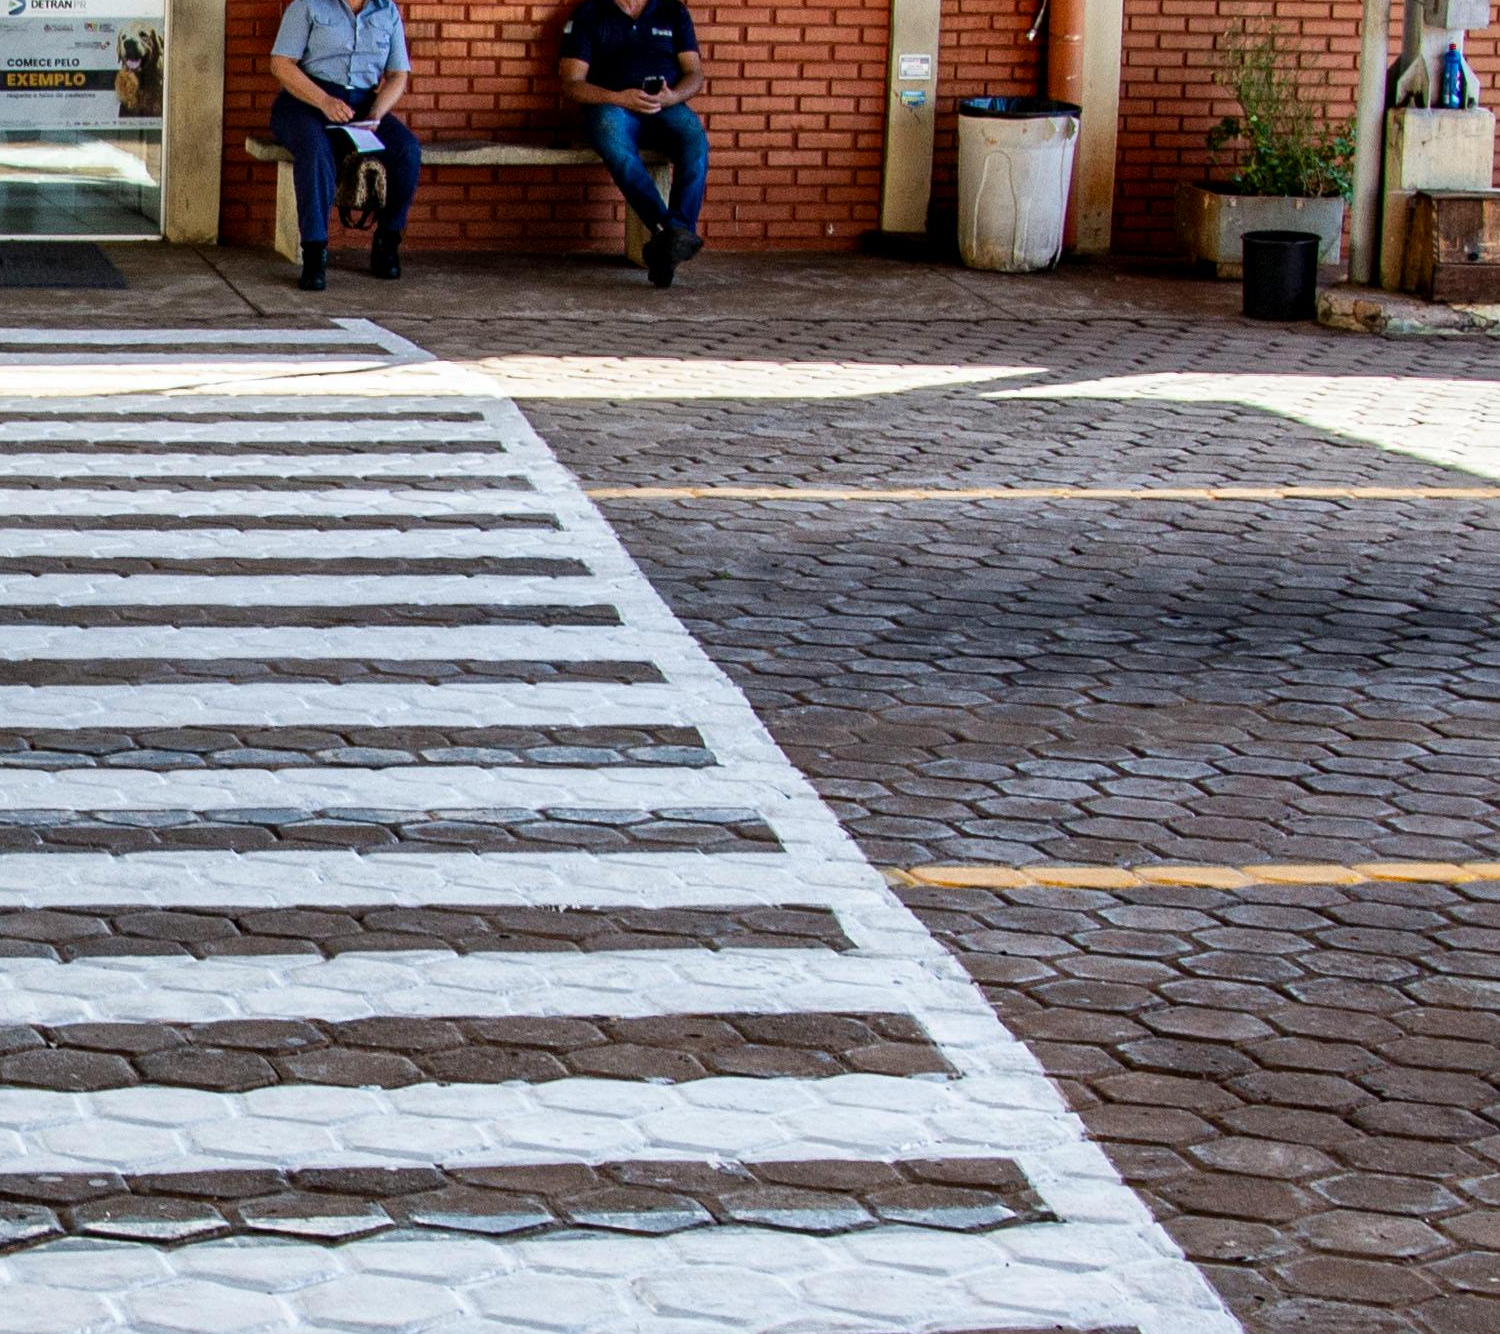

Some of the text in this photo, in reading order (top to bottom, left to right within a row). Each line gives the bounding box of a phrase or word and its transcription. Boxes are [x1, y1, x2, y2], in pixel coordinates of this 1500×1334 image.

[31, 0, 87, 9] DETRAN PR
[7, 57, 80, 67] COMECE PELO
[6, 72, 86, 87] EXEMPLO
